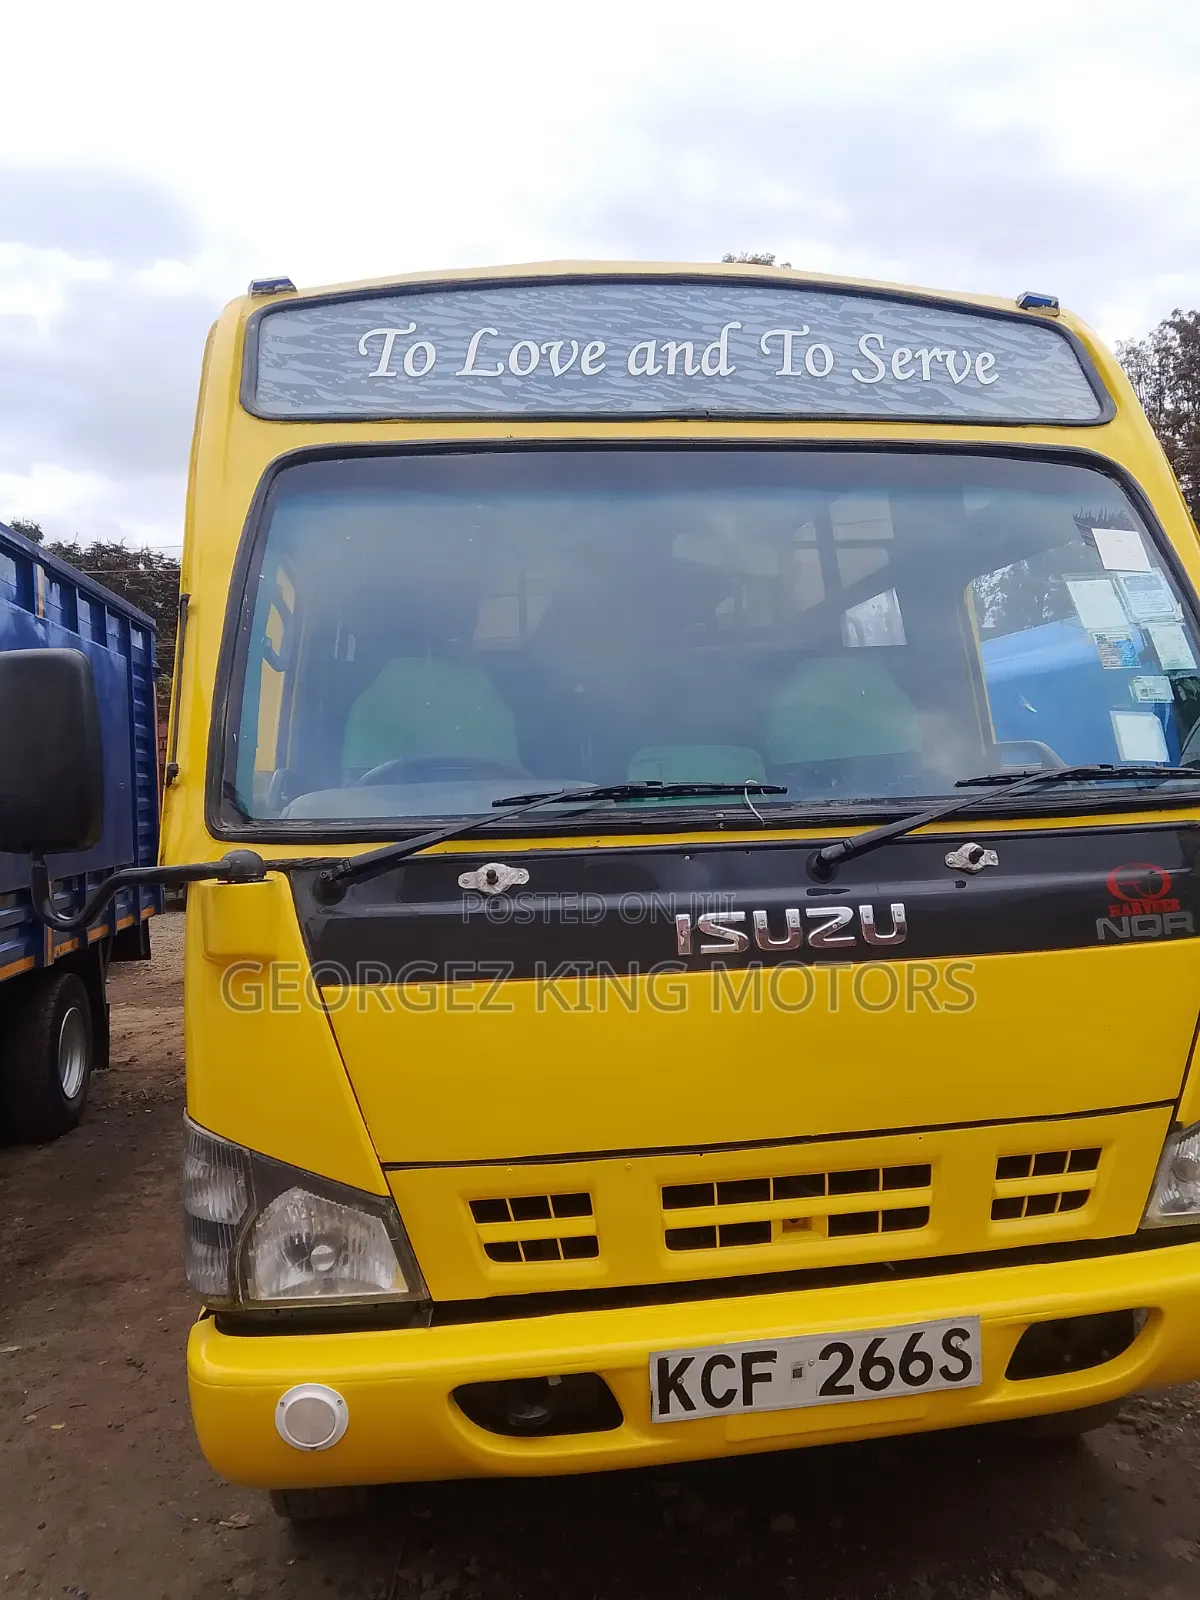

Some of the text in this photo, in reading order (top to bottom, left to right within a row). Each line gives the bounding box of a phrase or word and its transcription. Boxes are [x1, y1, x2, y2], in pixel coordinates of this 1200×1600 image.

[358, 321, 1000, 386] To Love and To Serve
[675, 903, 907, 956] ISUZU
[1095, 911, 1196, 940] NQR
[657, 1327, 973, 1415] KCF 266S
